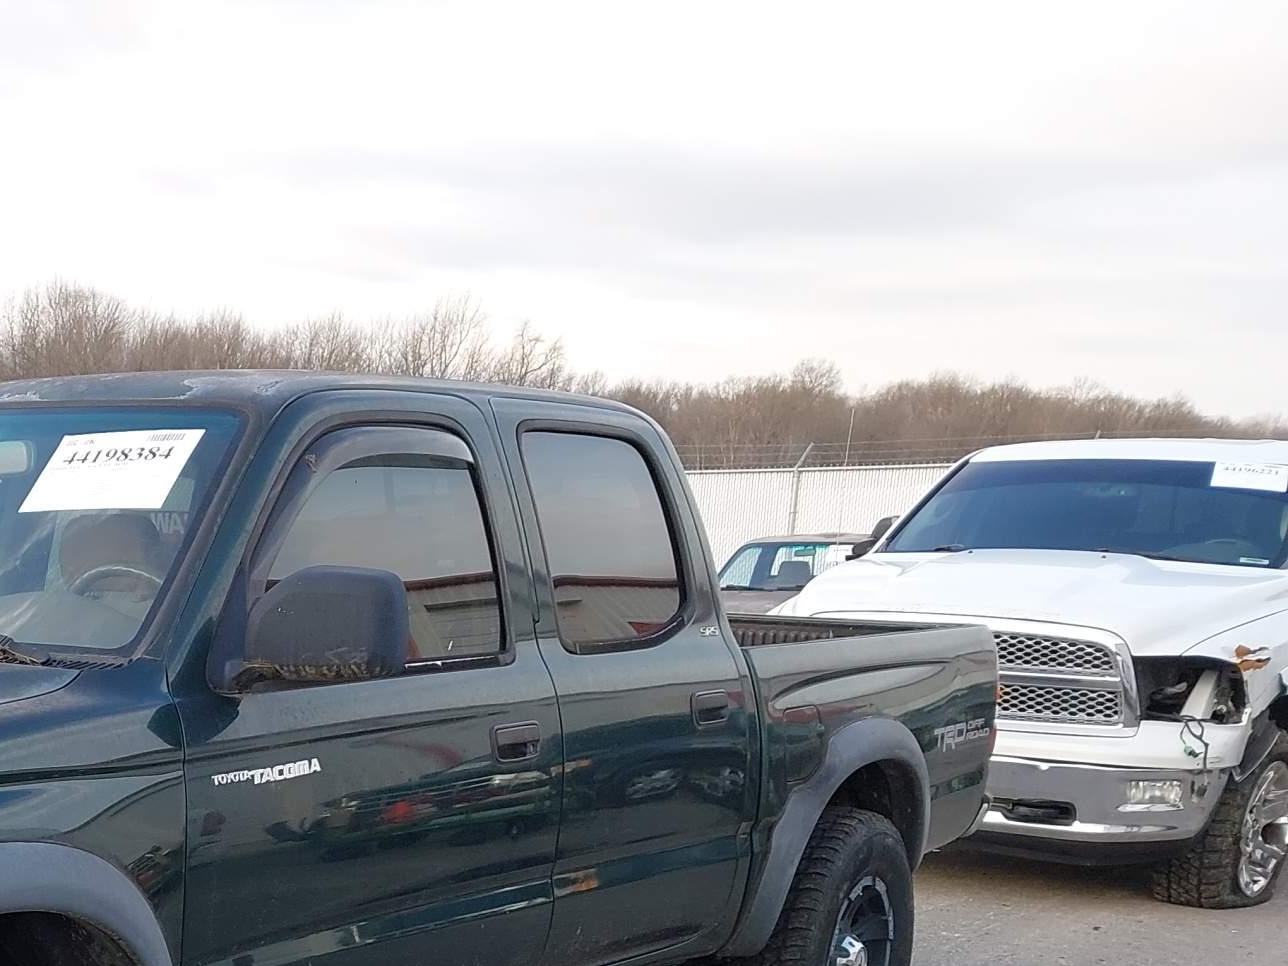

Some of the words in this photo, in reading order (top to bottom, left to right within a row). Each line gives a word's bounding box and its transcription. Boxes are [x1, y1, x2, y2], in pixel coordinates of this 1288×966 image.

[63, 446, 175, 465] 44198384
[934, 721, 966, 753] TRD
[212, 770, 251, 786] TOYOTA
[250, 757, 322, 785] TACOMA
